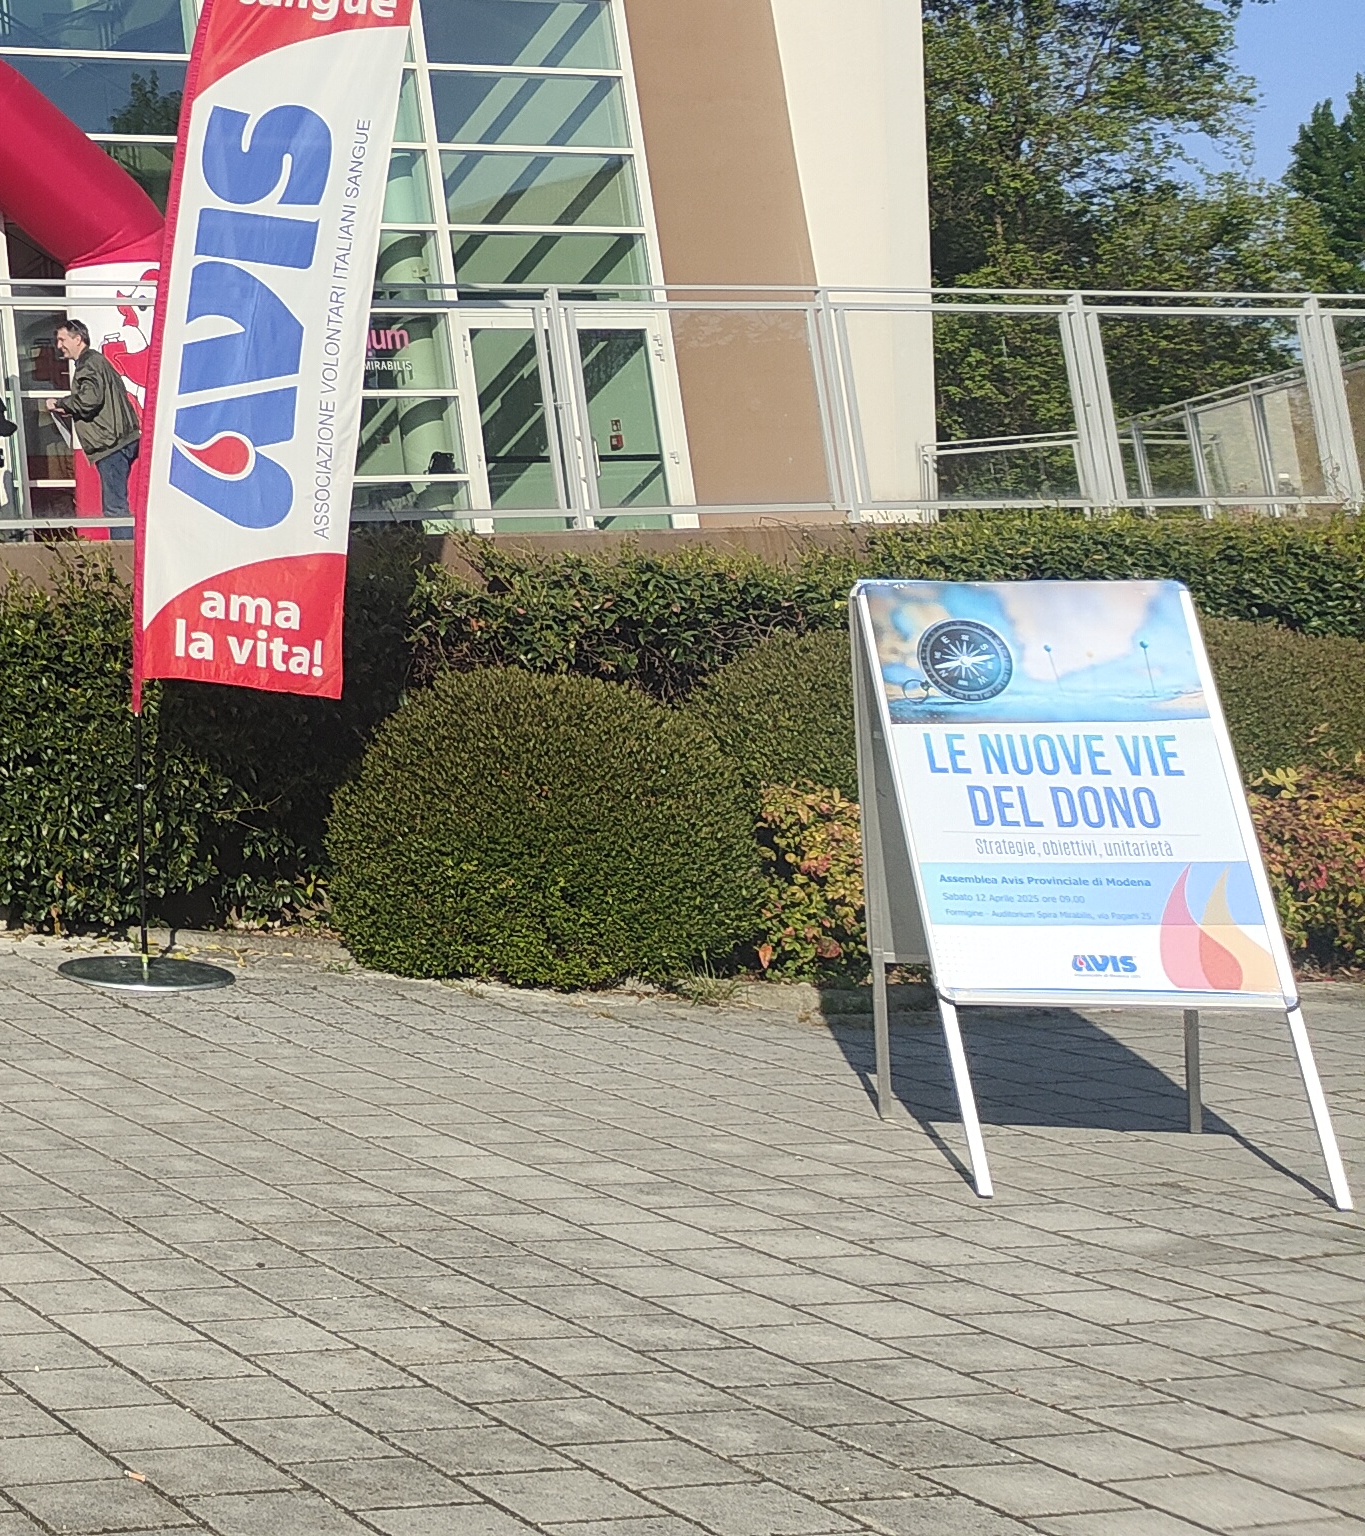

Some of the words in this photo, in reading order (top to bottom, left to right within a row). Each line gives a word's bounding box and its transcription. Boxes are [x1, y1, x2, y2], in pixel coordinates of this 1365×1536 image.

[344, 118, 372, 199] SANGUE
[331, 204, 358, 282] ITALIANI
[169, 104, 333, 530] AVIS
[320, 286, 347, 396] VOLONTARI
[313, 400, 337, 542] ASSOCIAZIONE
[200, 590, 300, 630] ama
[174, 620, 214, 659] la
[229, 628, 323, 678] vita!
[923, 733, 972, 774] LE
[978, 734, 1111, 776] NUOVE
[1115, 735, 1185, 776] VIE
[967, 785, 1044, 827] DEL
[1049, 786, 1161, 828] DONO
[975, 838, 1041, 857] Strategie,
[1043, 840, 1102, 858] obiettivi,
[1104, 840, 1173, 857] unitarietà
[939, 875, 997, 884] Assemblea
[1001, 876, 1024, 885] Avis
[1027, 877, 1089, 886] Provinciale
[1106, 878, 1151, 887] Modena
[942, 893, 973, 901] Sabato
[1072, 955, 1137, 972] AVIS
